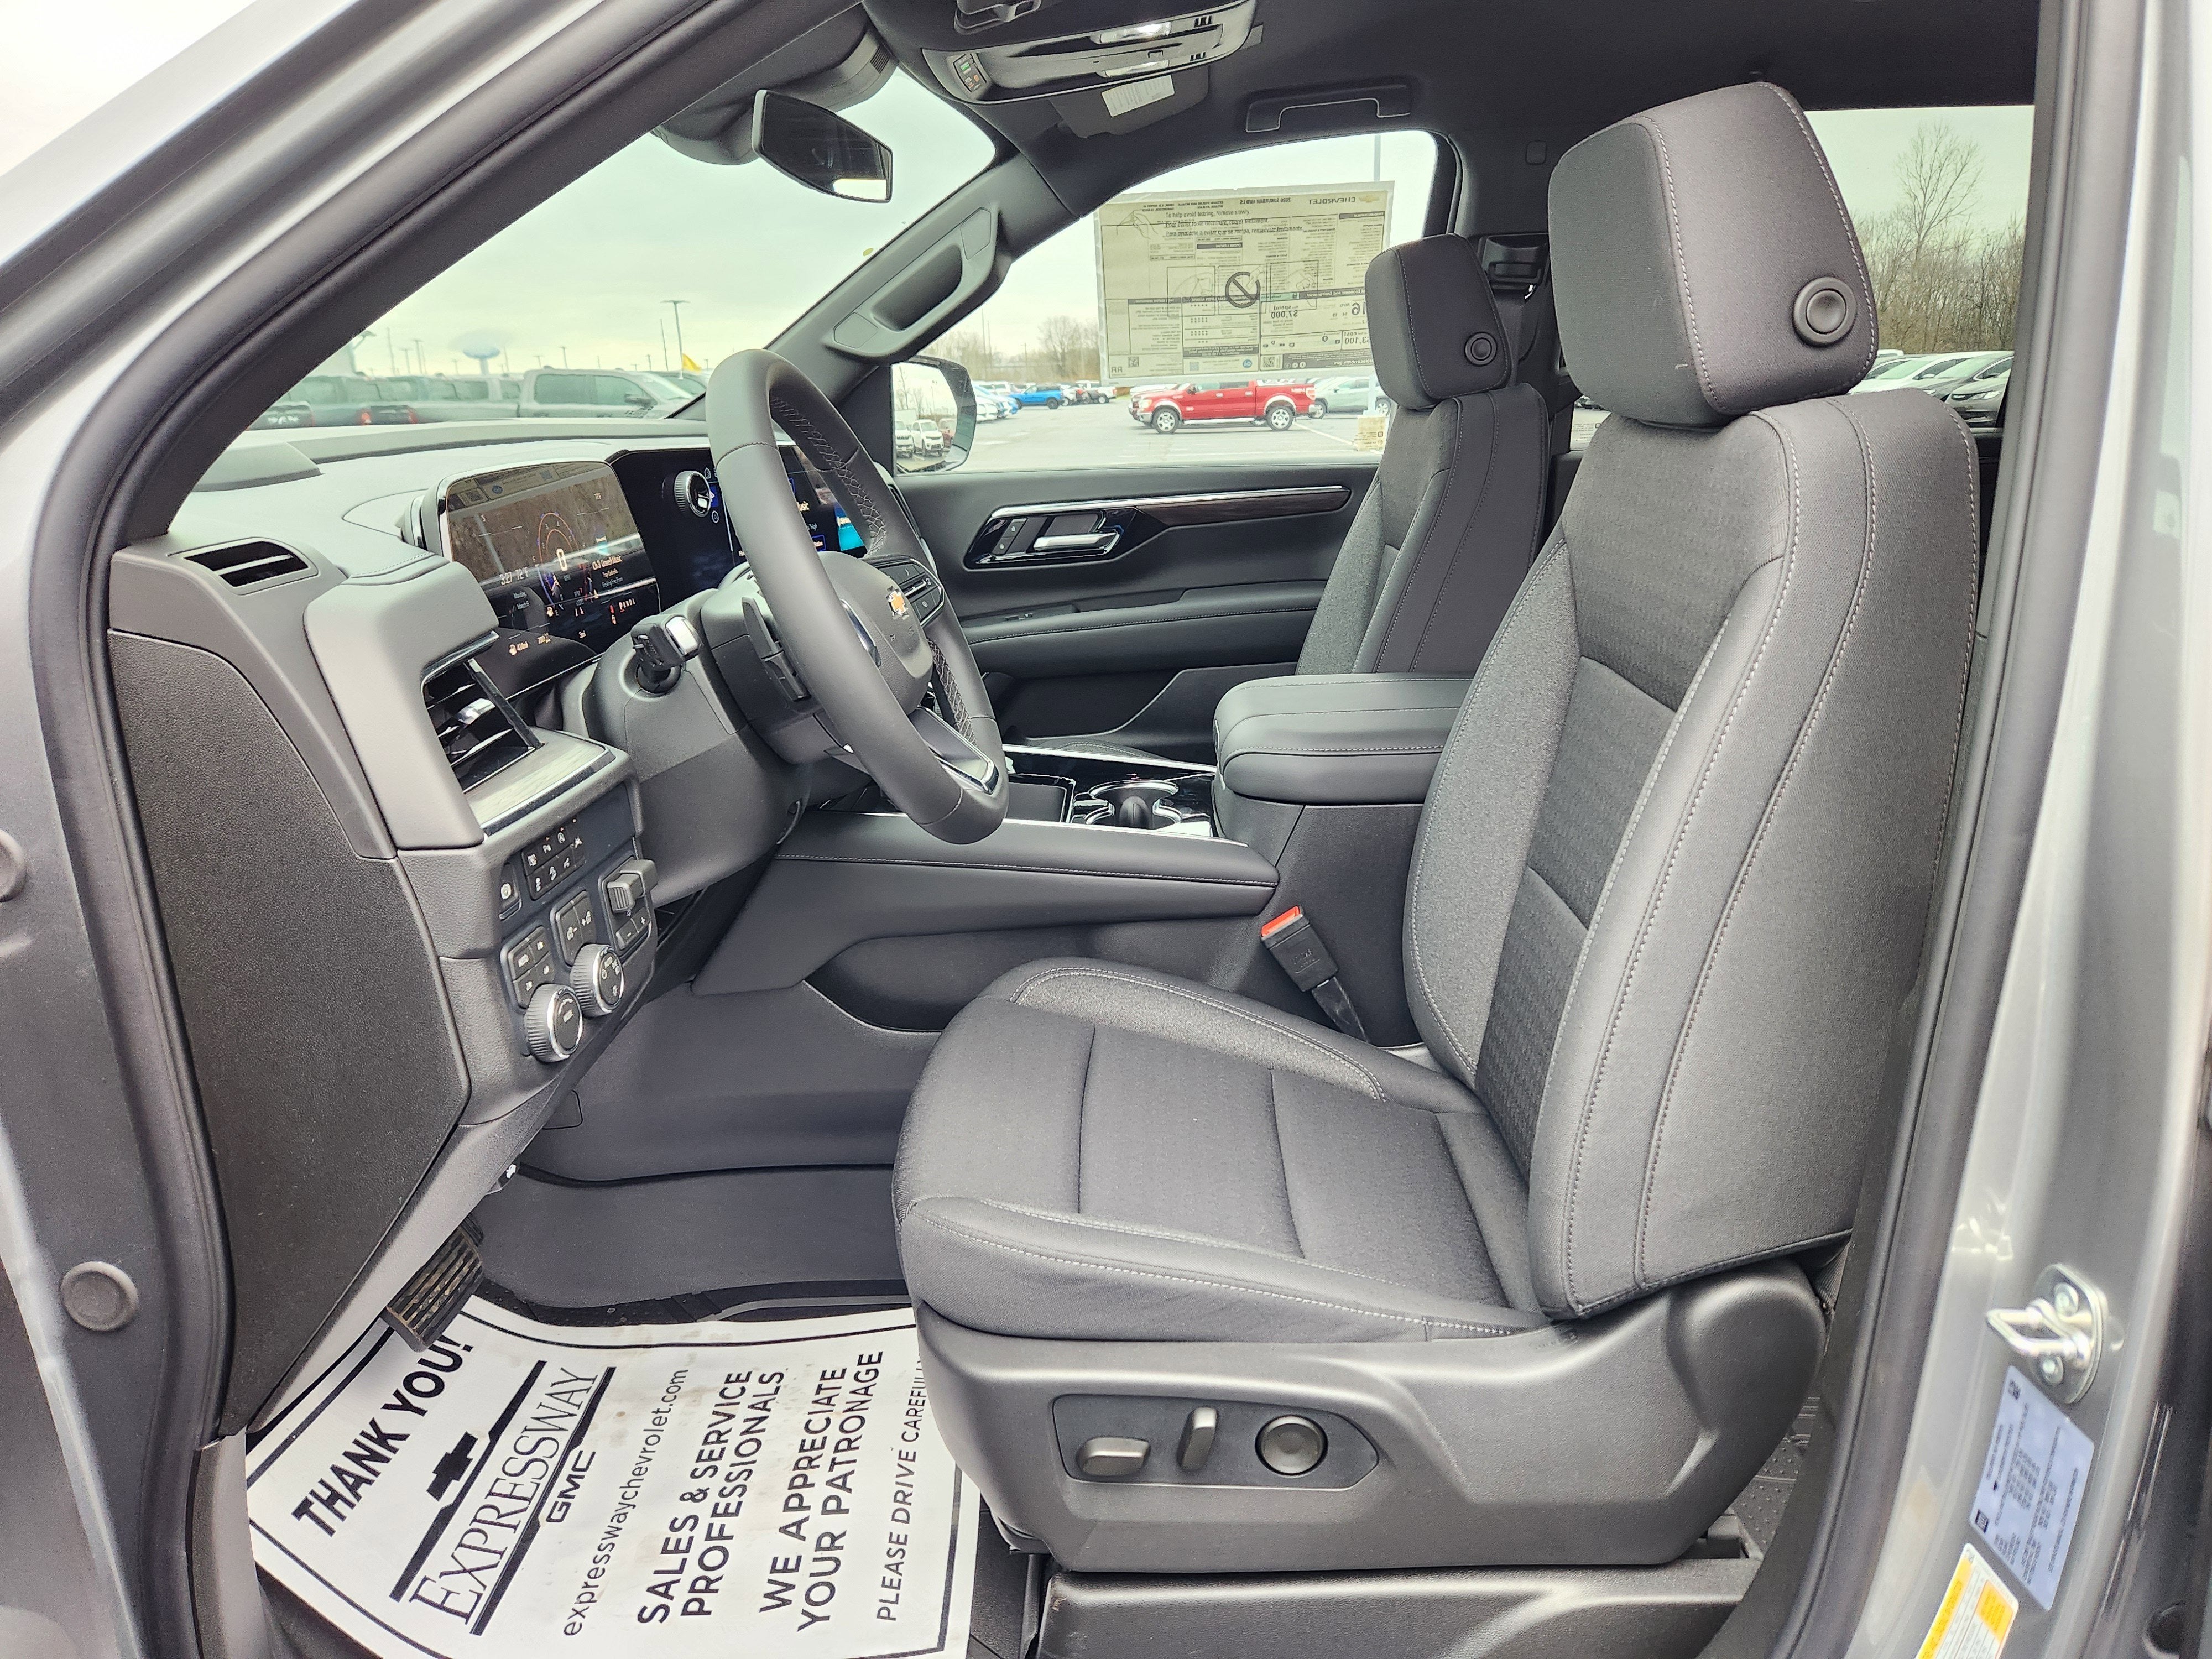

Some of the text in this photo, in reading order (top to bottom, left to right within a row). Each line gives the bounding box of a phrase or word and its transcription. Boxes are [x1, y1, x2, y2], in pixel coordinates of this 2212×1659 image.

[556, 548, 568, 572] 0
[797, 500, 810, 512] usic
[291, 1334, 473, 1537] THANK YOU!
[409, 1366, 598, 1625] EXPRESSWAY
[545, 1449, 596, 1524] GMC
[563, 1369, 689, 1637] expresswaychevrolet.com
[637, 1370, 753, 1624] SALES & SERVICE
[680, 1371, 784, 1616] PROFESSIONALS
[759, 1366, 847, 1614] WE APPRECIATE
[797, 1351, 884, 1632] YOUR PATRONAGE
[891, 1450, 916, 1524] DRIVE
[876, 1531, 909, 1621] PLEASE
